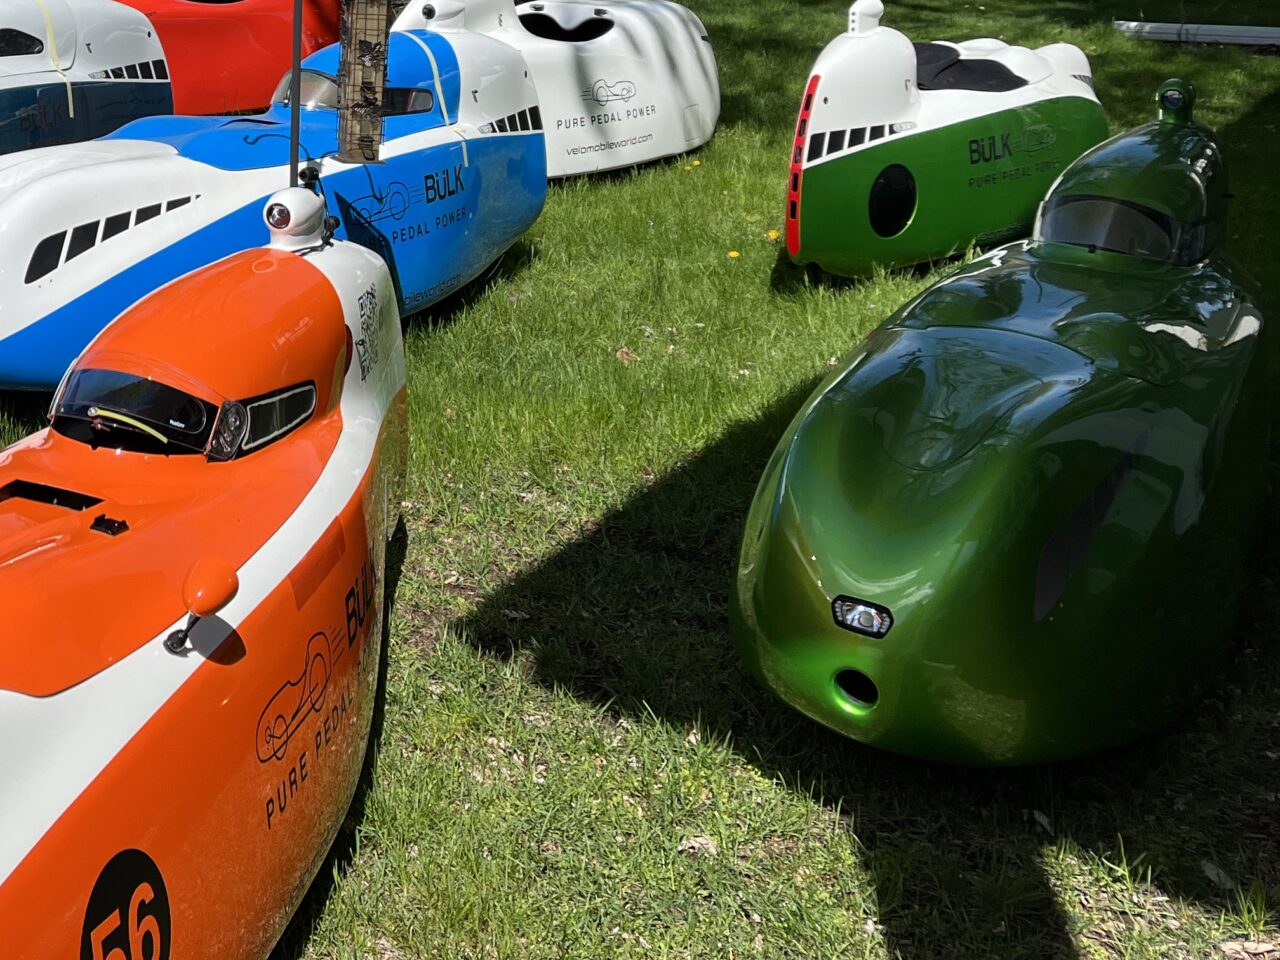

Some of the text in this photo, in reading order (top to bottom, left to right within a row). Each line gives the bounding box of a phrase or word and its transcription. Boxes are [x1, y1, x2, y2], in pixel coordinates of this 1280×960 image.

[557, 105, 656, 130] PURE PEDAL POWER
[567, 133, 653, 156] velomobileworld.com
[969, 133, 1012, 165] BÜLK
[424, 164, 465, 204] BÜLK
[392, 222, 430, 245] PEDAL
[436, 206, 466, 229] POWER
[266, 683, 353, 830] PURE PEDAL
